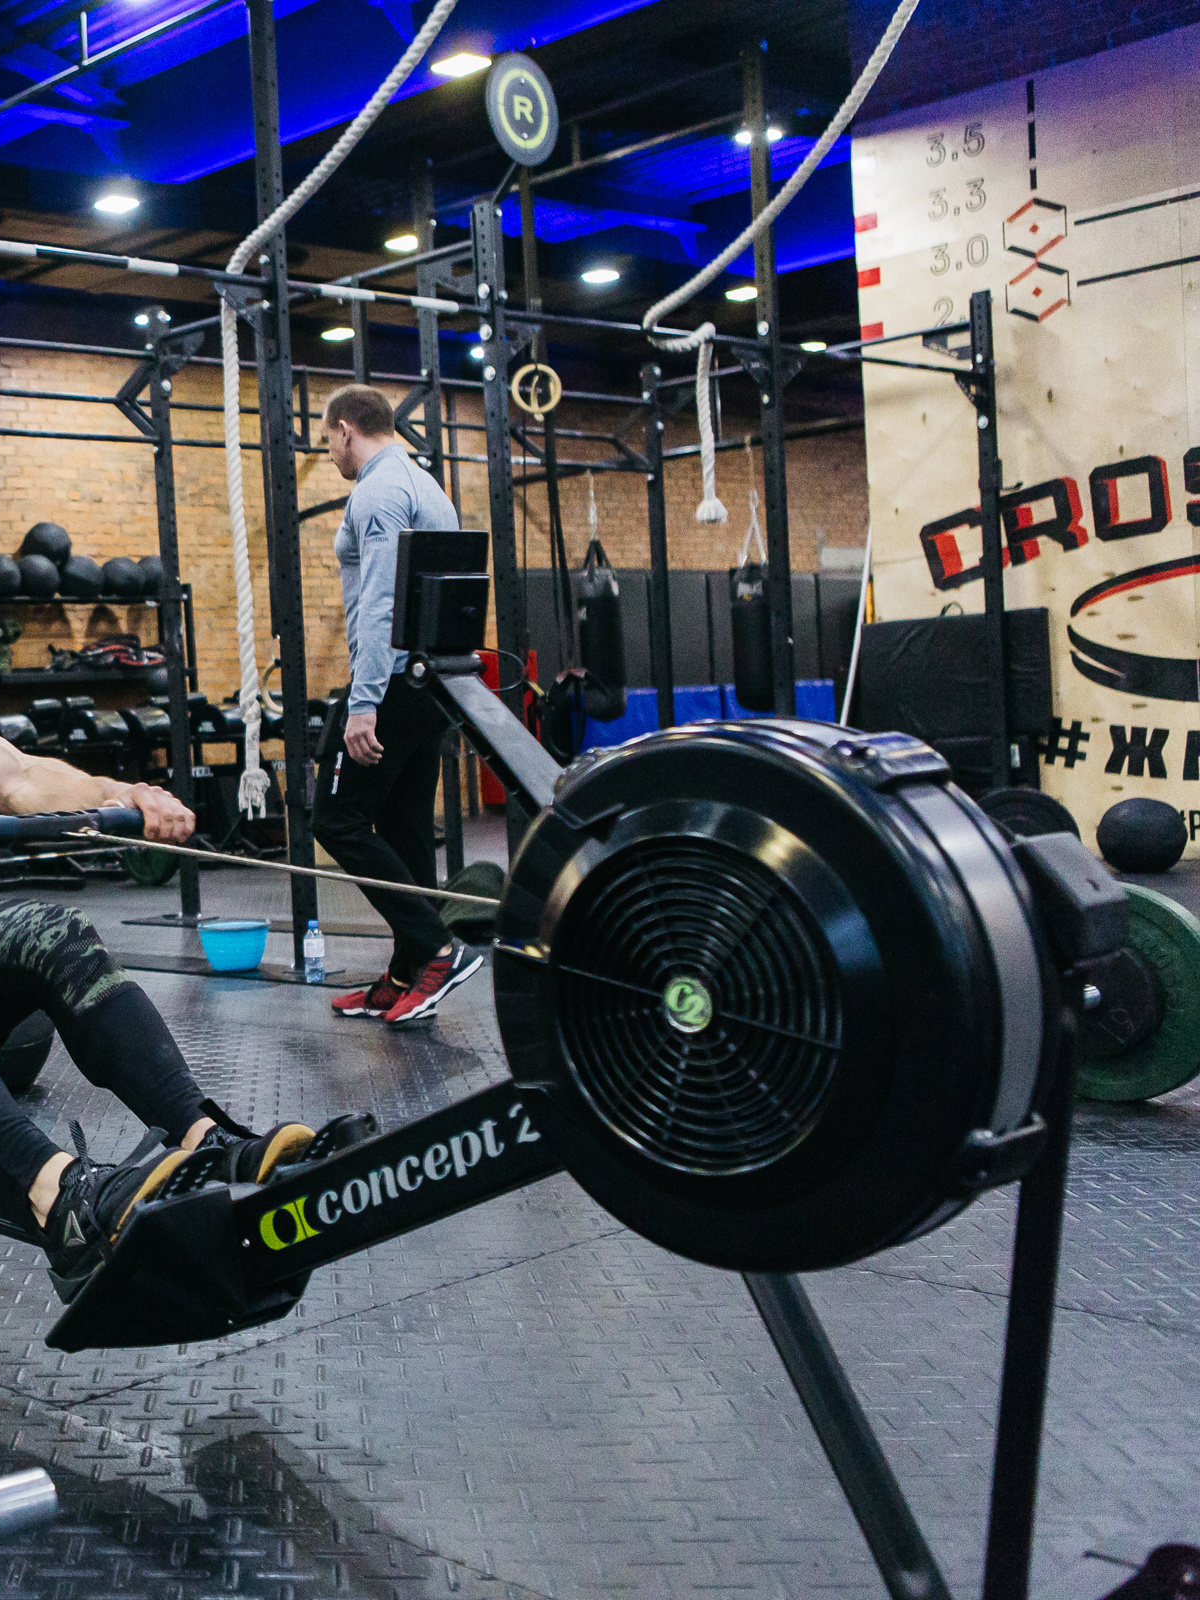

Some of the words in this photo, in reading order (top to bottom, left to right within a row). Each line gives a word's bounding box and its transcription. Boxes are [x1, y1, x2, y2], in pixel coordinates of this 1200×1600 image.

[512, 93, 535, 124] R
[925, 121, 986, 168] 3.5
[927, 177, 988, 222] 3.3
[929, 233, 990, 276] 3.0
[919, 446, 1200, 592] CRO
[316, 1117, 506, 1225] concept
[508, 1102, 542, 1144] 2
